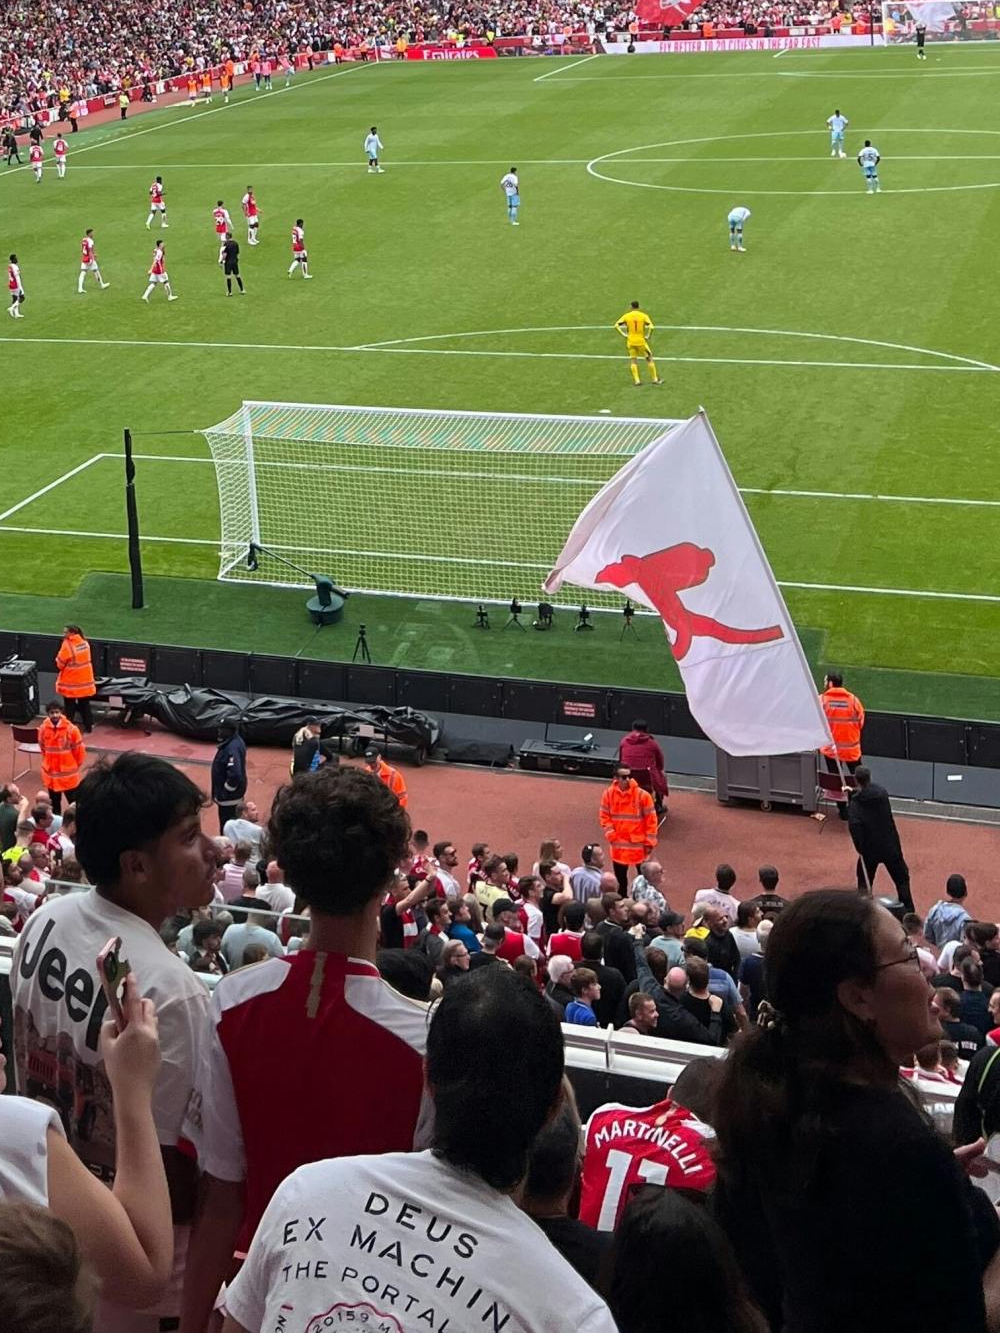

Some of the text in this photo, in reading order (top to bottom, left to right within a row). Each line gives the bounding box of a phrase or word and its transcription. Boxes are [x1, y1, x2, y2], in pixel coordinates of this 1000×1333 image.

[423, 49, 480, 60] Emirates
[594, 1119, 703, 1175] MARTINELLI
[283, 1217, 327, 1246] EX
[364, 1191, 479, 1259] DEUS
[283, 1260, 329, 1283] THE
